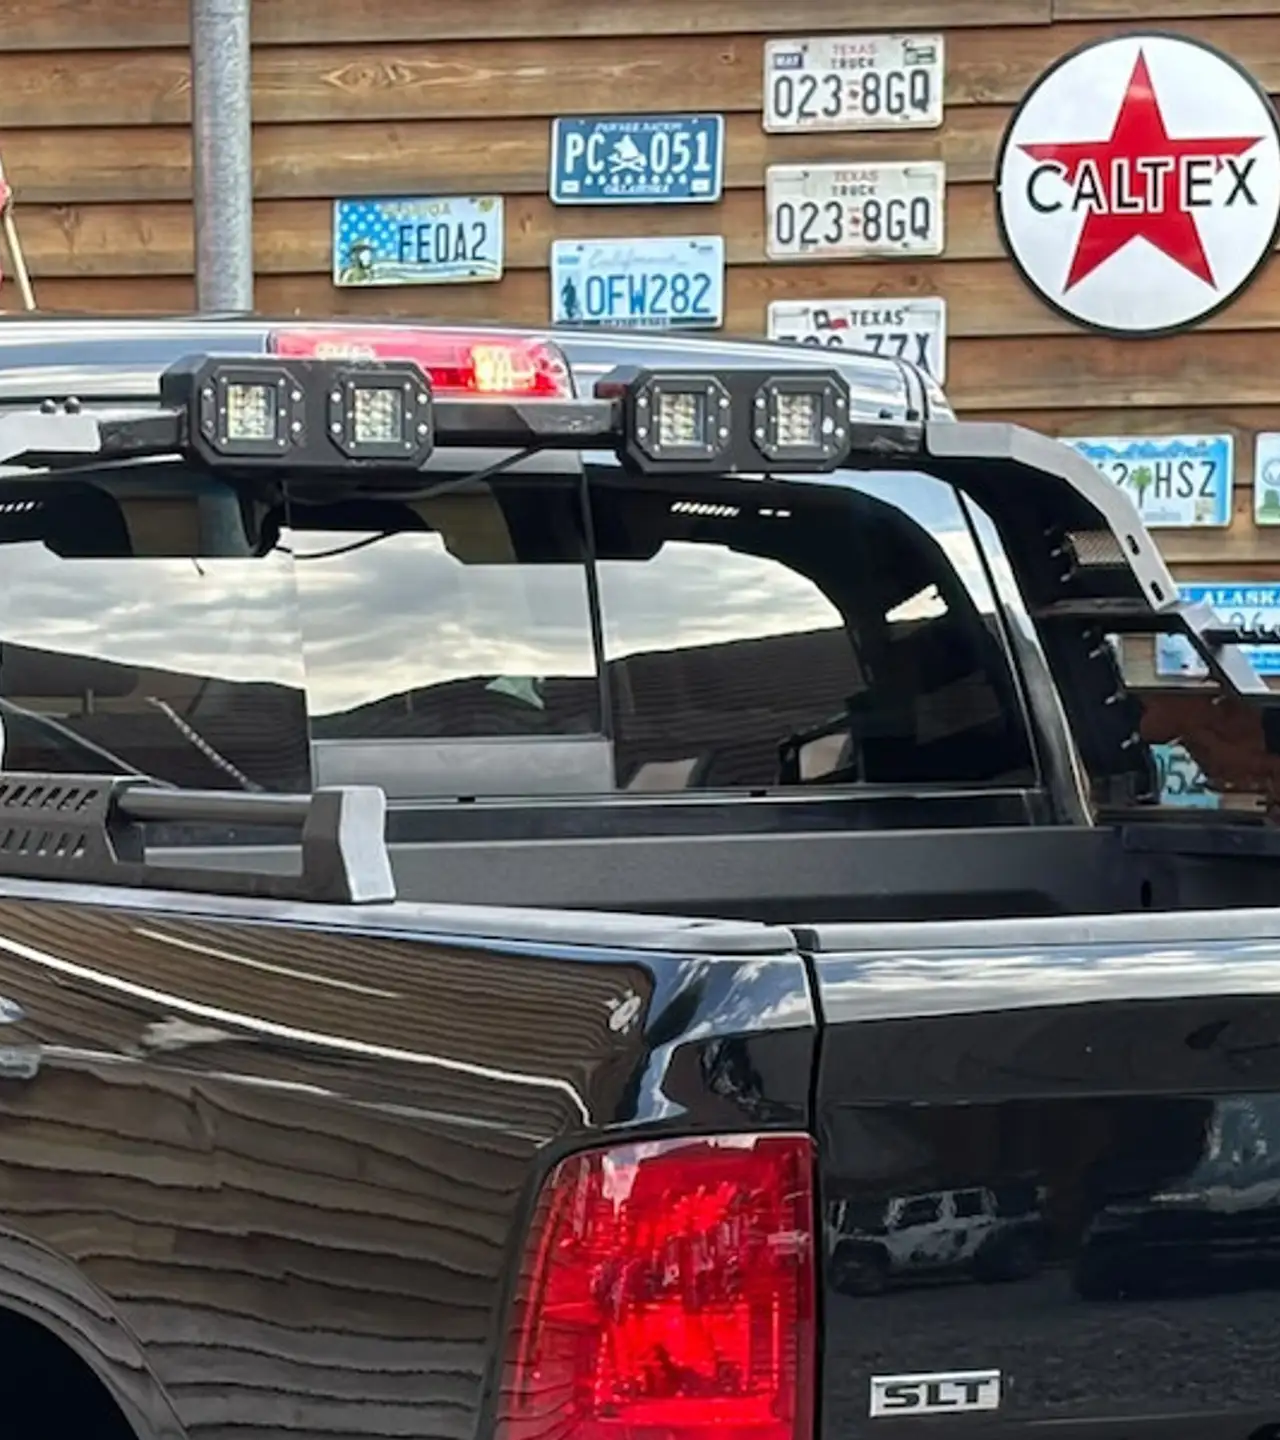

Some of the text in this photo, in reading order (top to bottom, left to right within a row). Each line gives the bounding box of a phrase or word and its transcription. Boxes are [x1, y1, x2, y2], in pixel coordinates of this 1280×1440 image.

[831, 57, 875, 68] TRUCK
[774, 69, 929, 118] 023 8GQ
[565, 130, 711, 174] PC 051
[831, 184, 876, 195] TRUCK
[1026, 158, 1258, 214] CALTEX
[776, 197, 929, 244] 023 8GQ
[850, 310, 904, 326] TEXAS
[1154, 460, 1217, 498] HSZ
[883, 1380, 990, 1408] SLT
